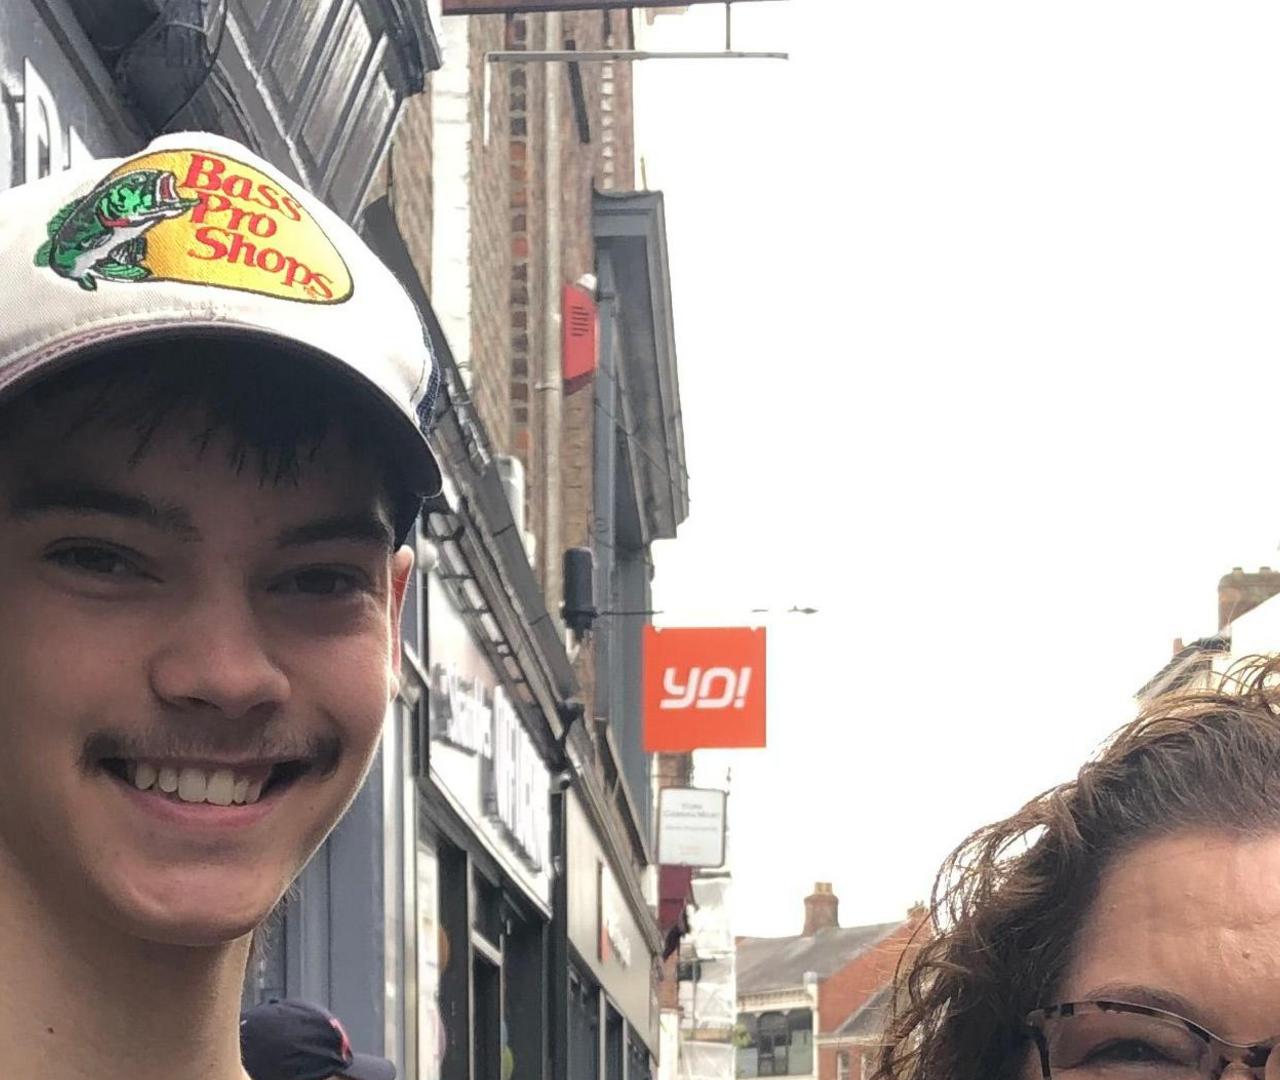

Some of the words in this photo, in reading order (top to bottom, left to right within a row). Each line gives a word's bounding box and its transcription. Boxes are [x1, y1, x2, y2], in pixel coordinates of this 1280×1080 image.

[180, 152, 302, 222] Bass
[190, 190, 278, 239] Pro
[187, 226, 334, 300] Shops
[660, 666, 752, 710] YO!
